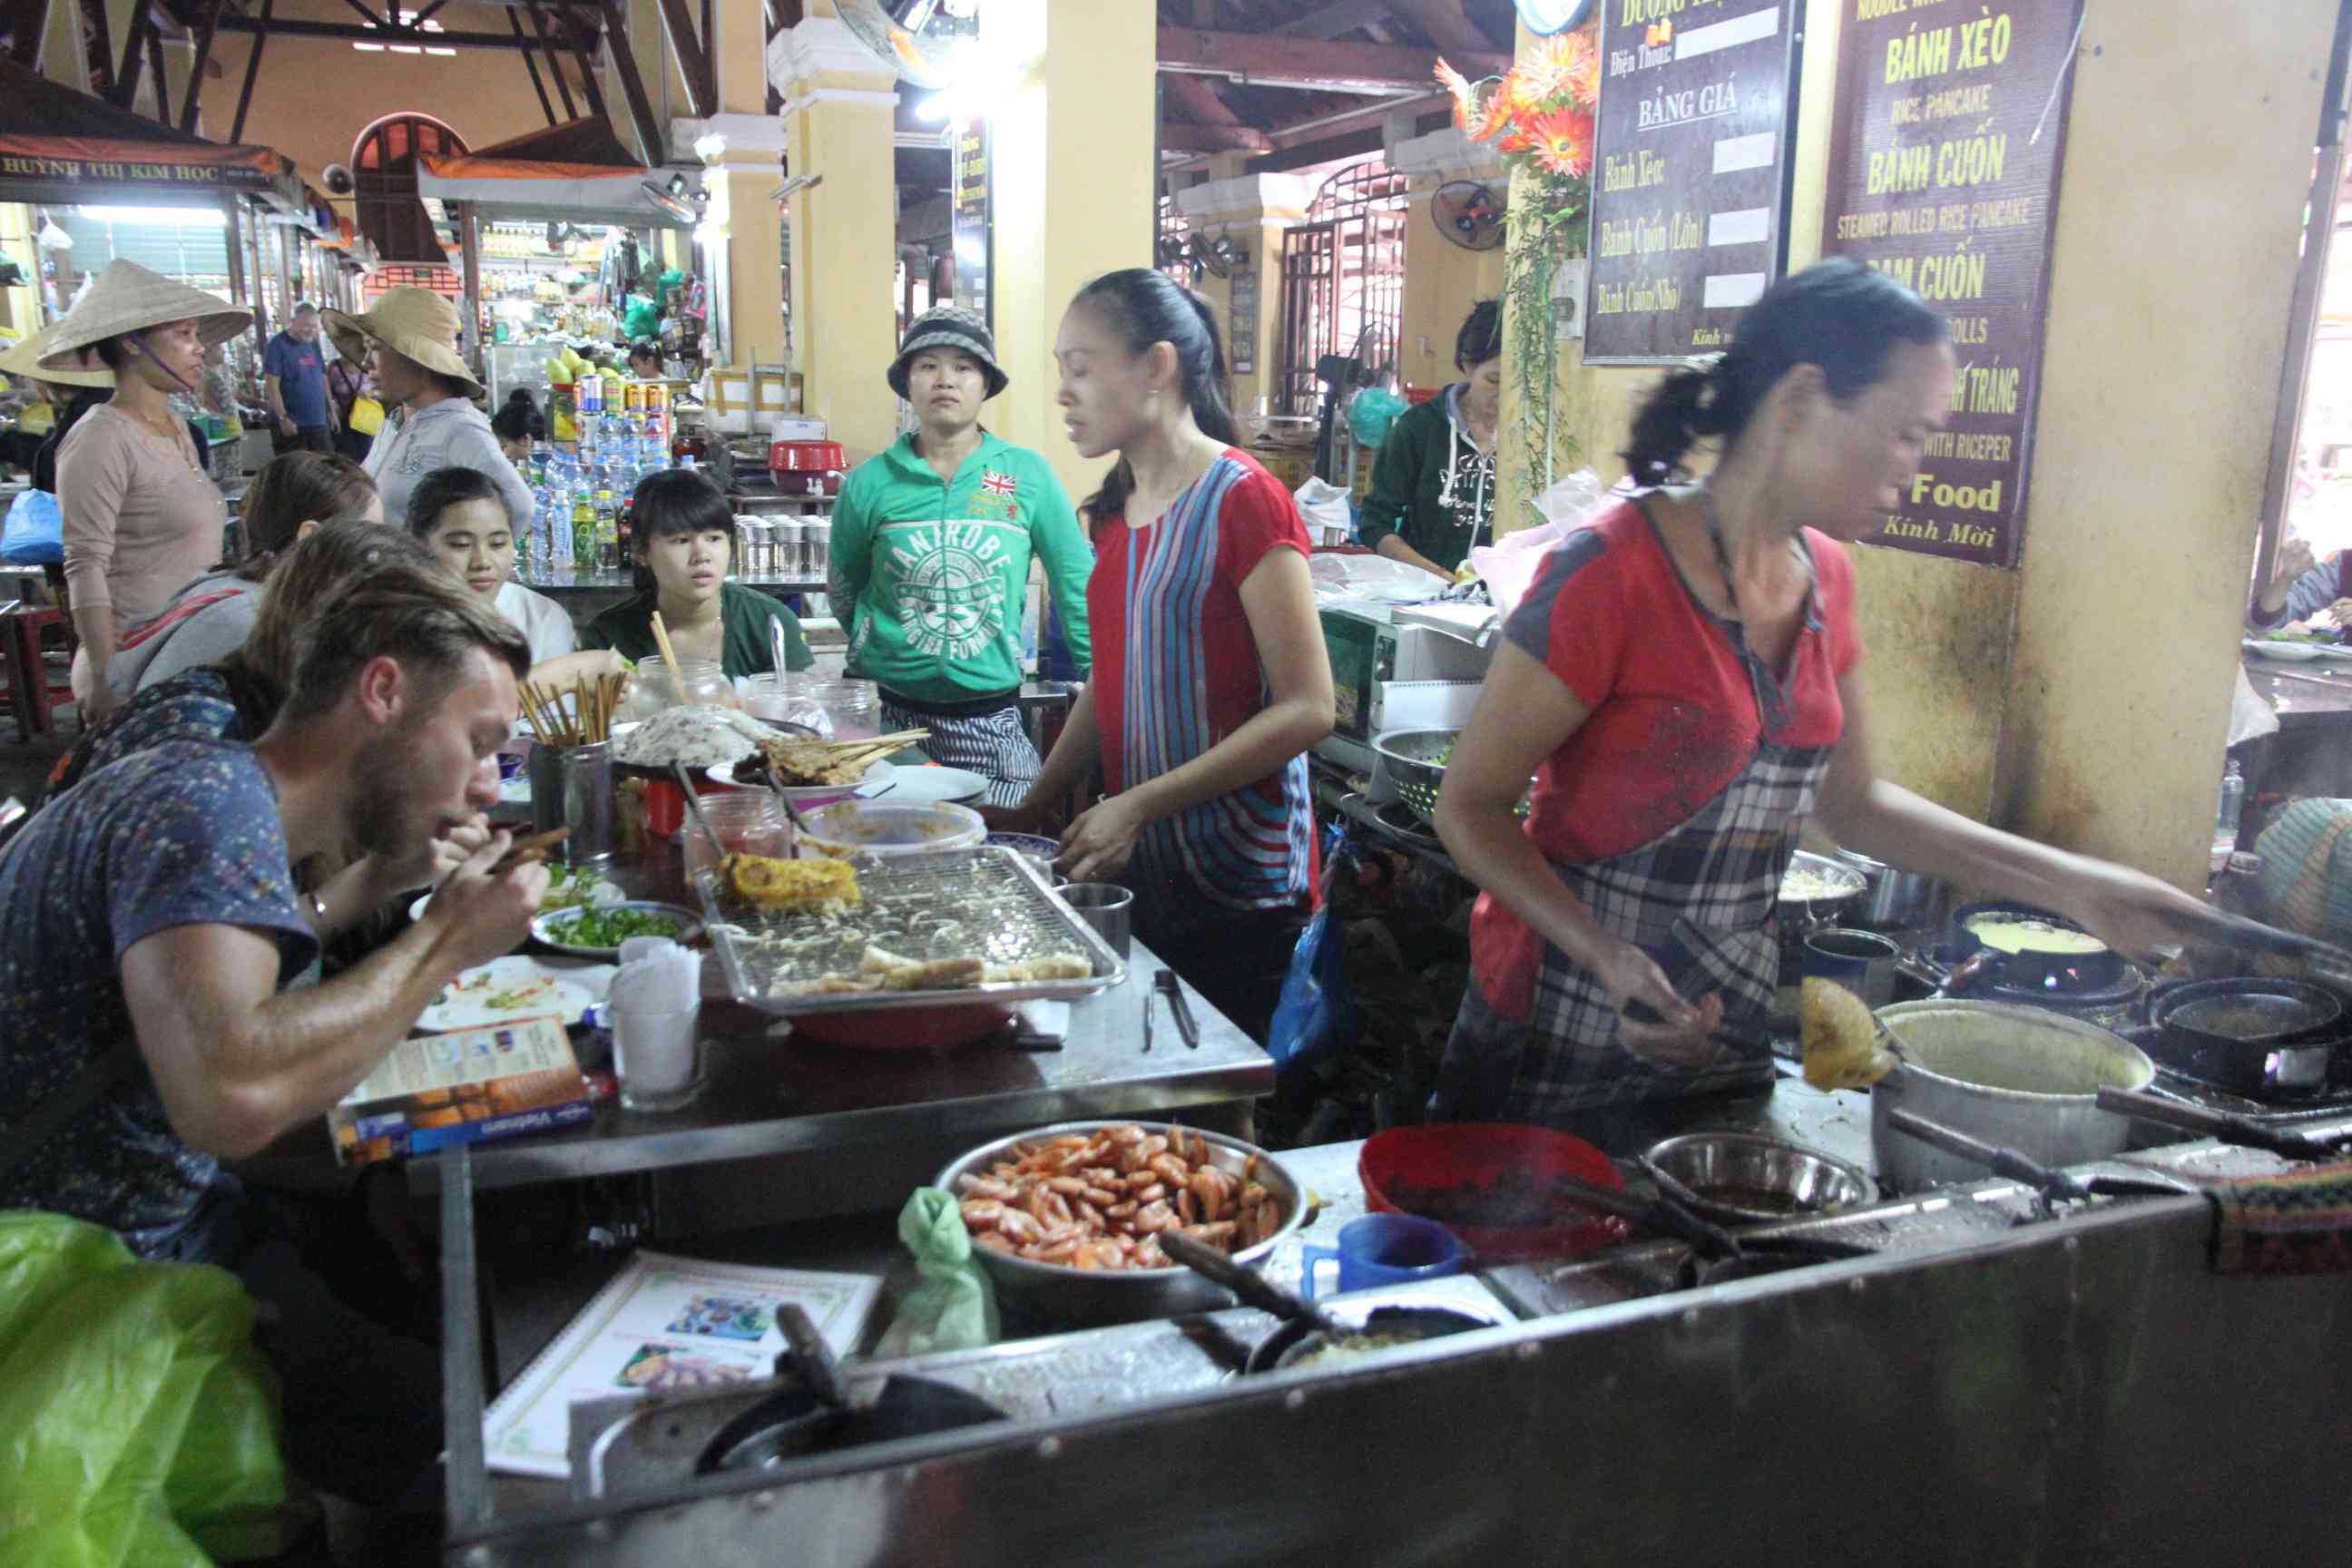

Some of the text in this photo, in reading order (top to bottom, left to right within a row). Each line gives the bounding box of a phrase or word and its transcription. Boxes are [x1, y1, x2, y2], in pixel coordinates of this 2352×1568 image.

[1885, 5, 2011, 84] BÁNH XÈO
[1638, 72, 1738, 127] BẢNG GIÁ
[1890, 83, 1992, 124] RICE PANCAKE
[3, 156, 80, 175] HUỲNH
[131, 164, 170, 179] KIM
[1604, 152, 1634, 192] Bánh
[1867, 116, 2007, 195] BÁNH CUỐN
[1938, 203, 1968, 232] RICE
[1918, 235, 1988, 299] CUỐN
[1947, 318, 1988, 344] OLLS
[1923, 431, 2013, 461] WITH RICEPER
[1911, 473, 2002, 512] Food
[1884, 514, 1939, 540] Kính
